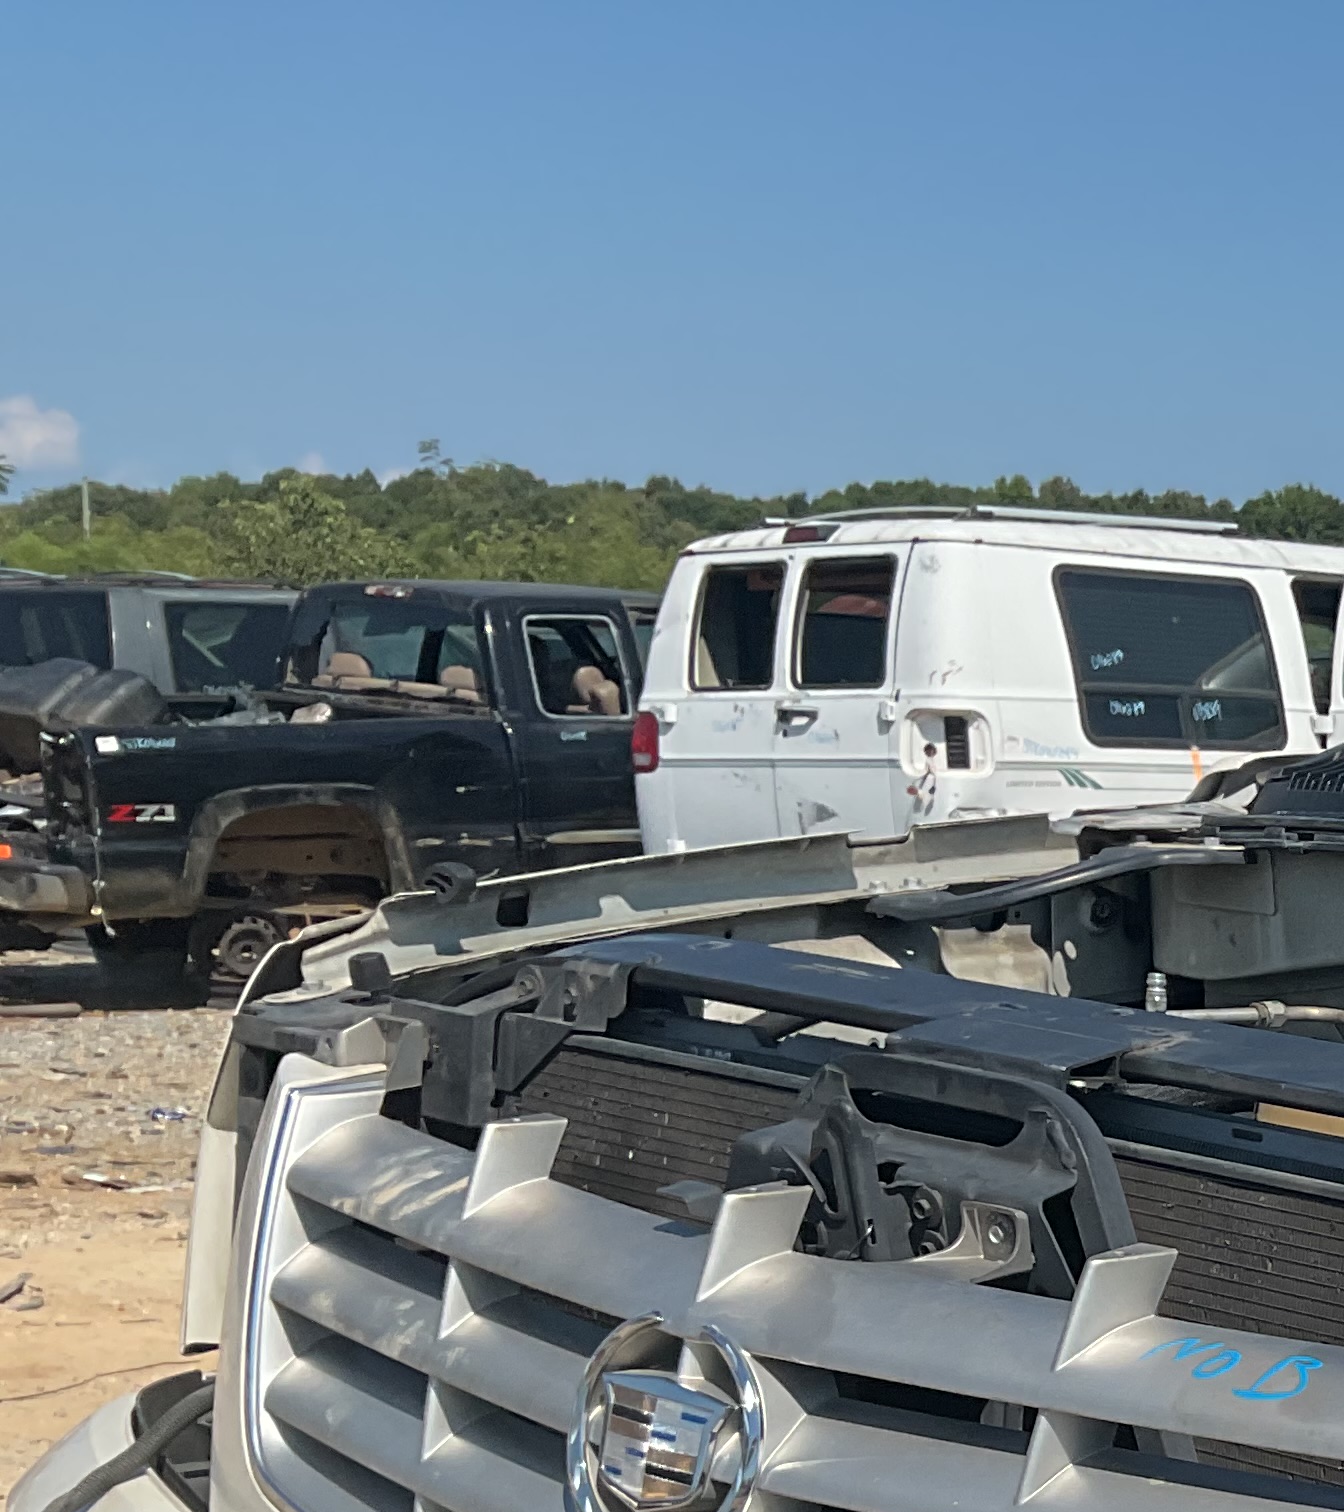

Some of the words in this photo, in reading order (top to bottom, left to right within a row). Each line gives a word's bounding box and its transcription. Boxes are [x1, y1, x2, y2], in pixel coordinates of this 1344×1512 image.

[107, 803, 176, 823] Z71
[1139, 1336, 1243, 1380] NO
[1231, 1354, 1324, 1401] B
